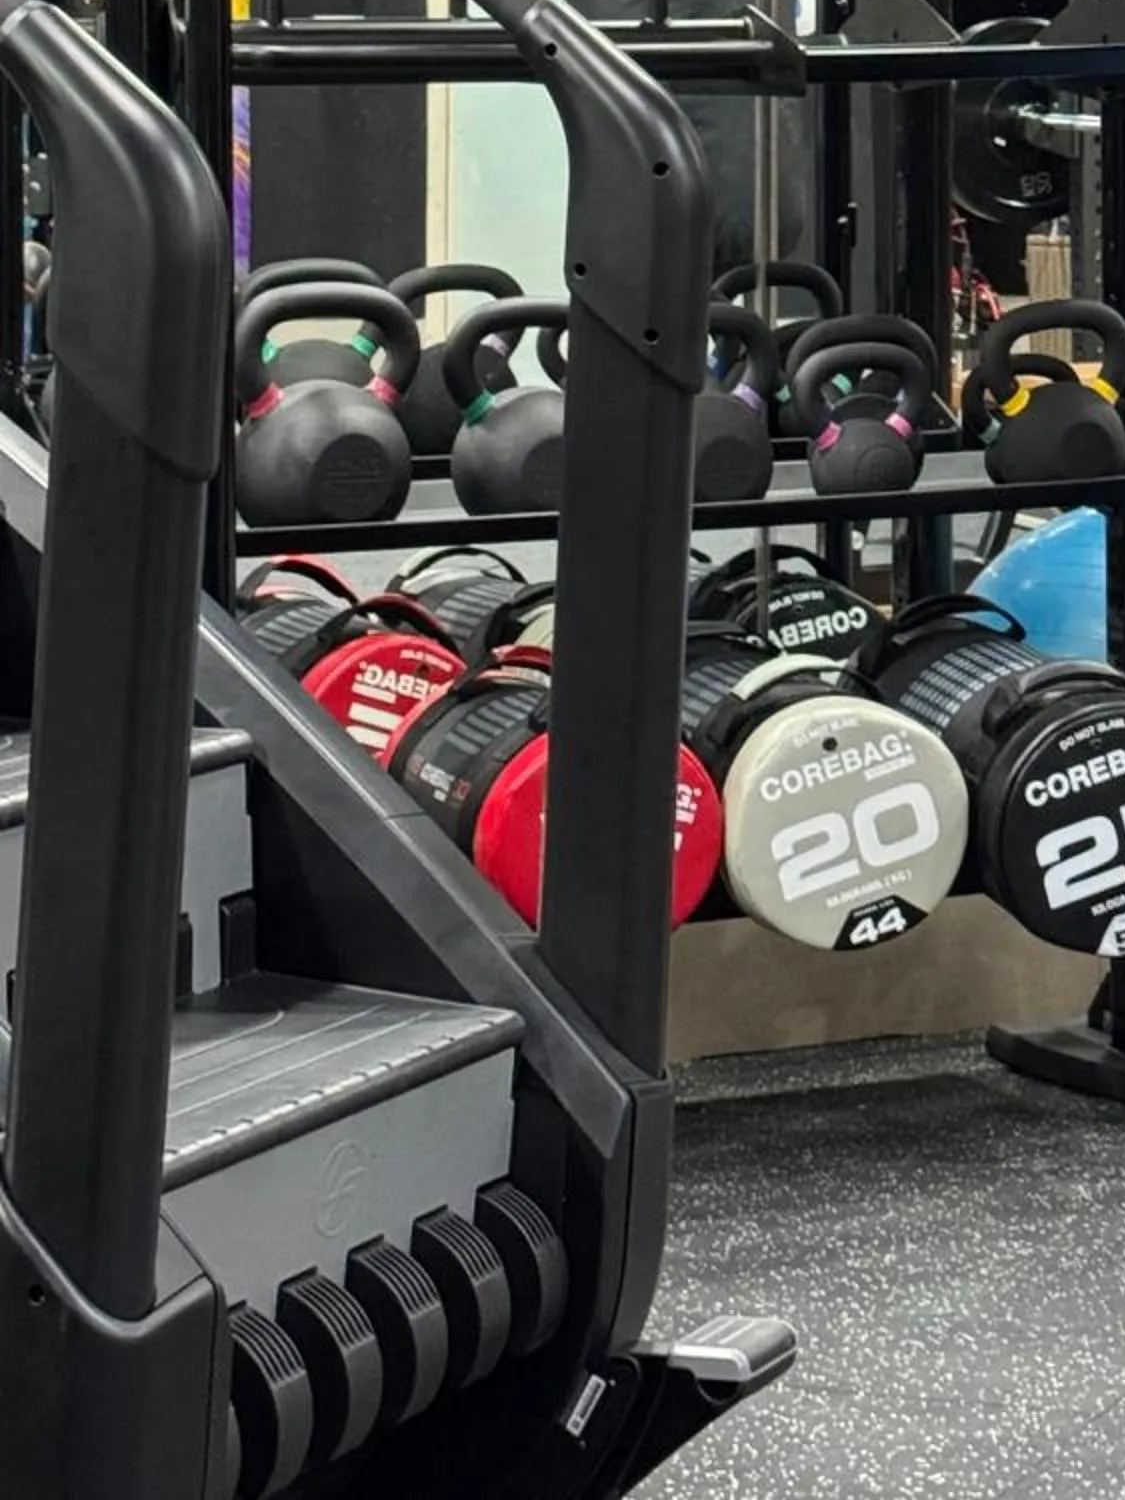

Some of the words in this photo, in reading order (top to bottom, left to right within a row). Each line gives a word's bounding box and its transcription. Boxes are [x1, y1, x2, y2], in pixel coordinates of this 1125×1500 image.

[1058, 736, 1075, 751] DO
[1075, 726, 1096, 741] NOT
[771, 781, 939, 901] 20
[849, 906, 907, 945] 44
